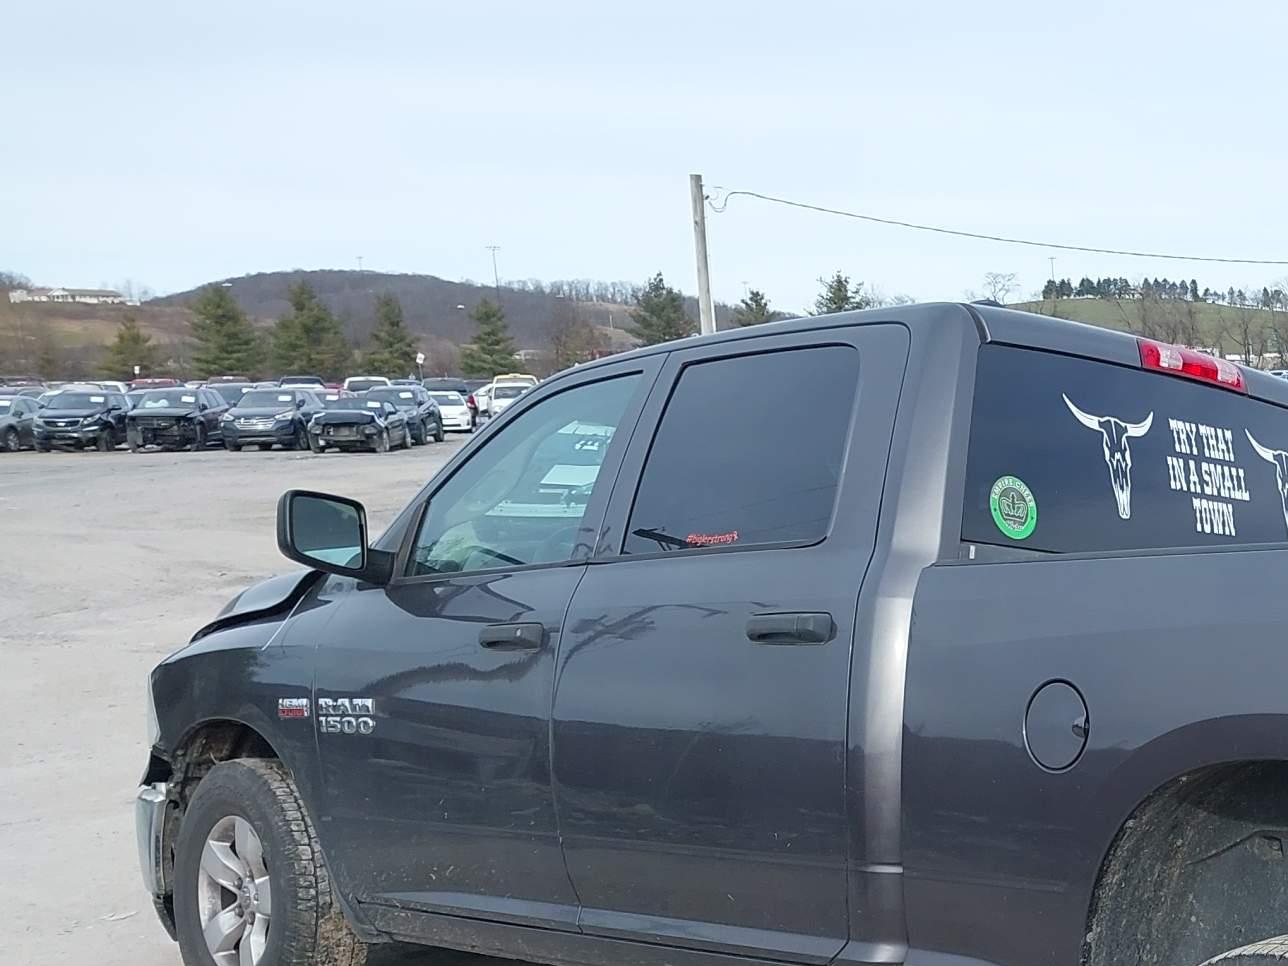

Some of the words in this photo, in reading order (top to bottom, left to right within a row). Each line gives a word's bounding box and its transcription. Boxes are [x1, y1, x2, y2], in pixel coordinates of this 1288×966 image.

[1169, 418, 1198, 455] TRY
[1198, 423, 1235, 462] THAT
[1166, 455, 1188, 491] IN
[1189, 459, 1201, 494] A
[1201, 461, 1250, 501] SMALL
[1192, 496, 1236, 537] TOWN
[318, 698, 375, 715] RAM
[319, 716, 375, 735] 1500
